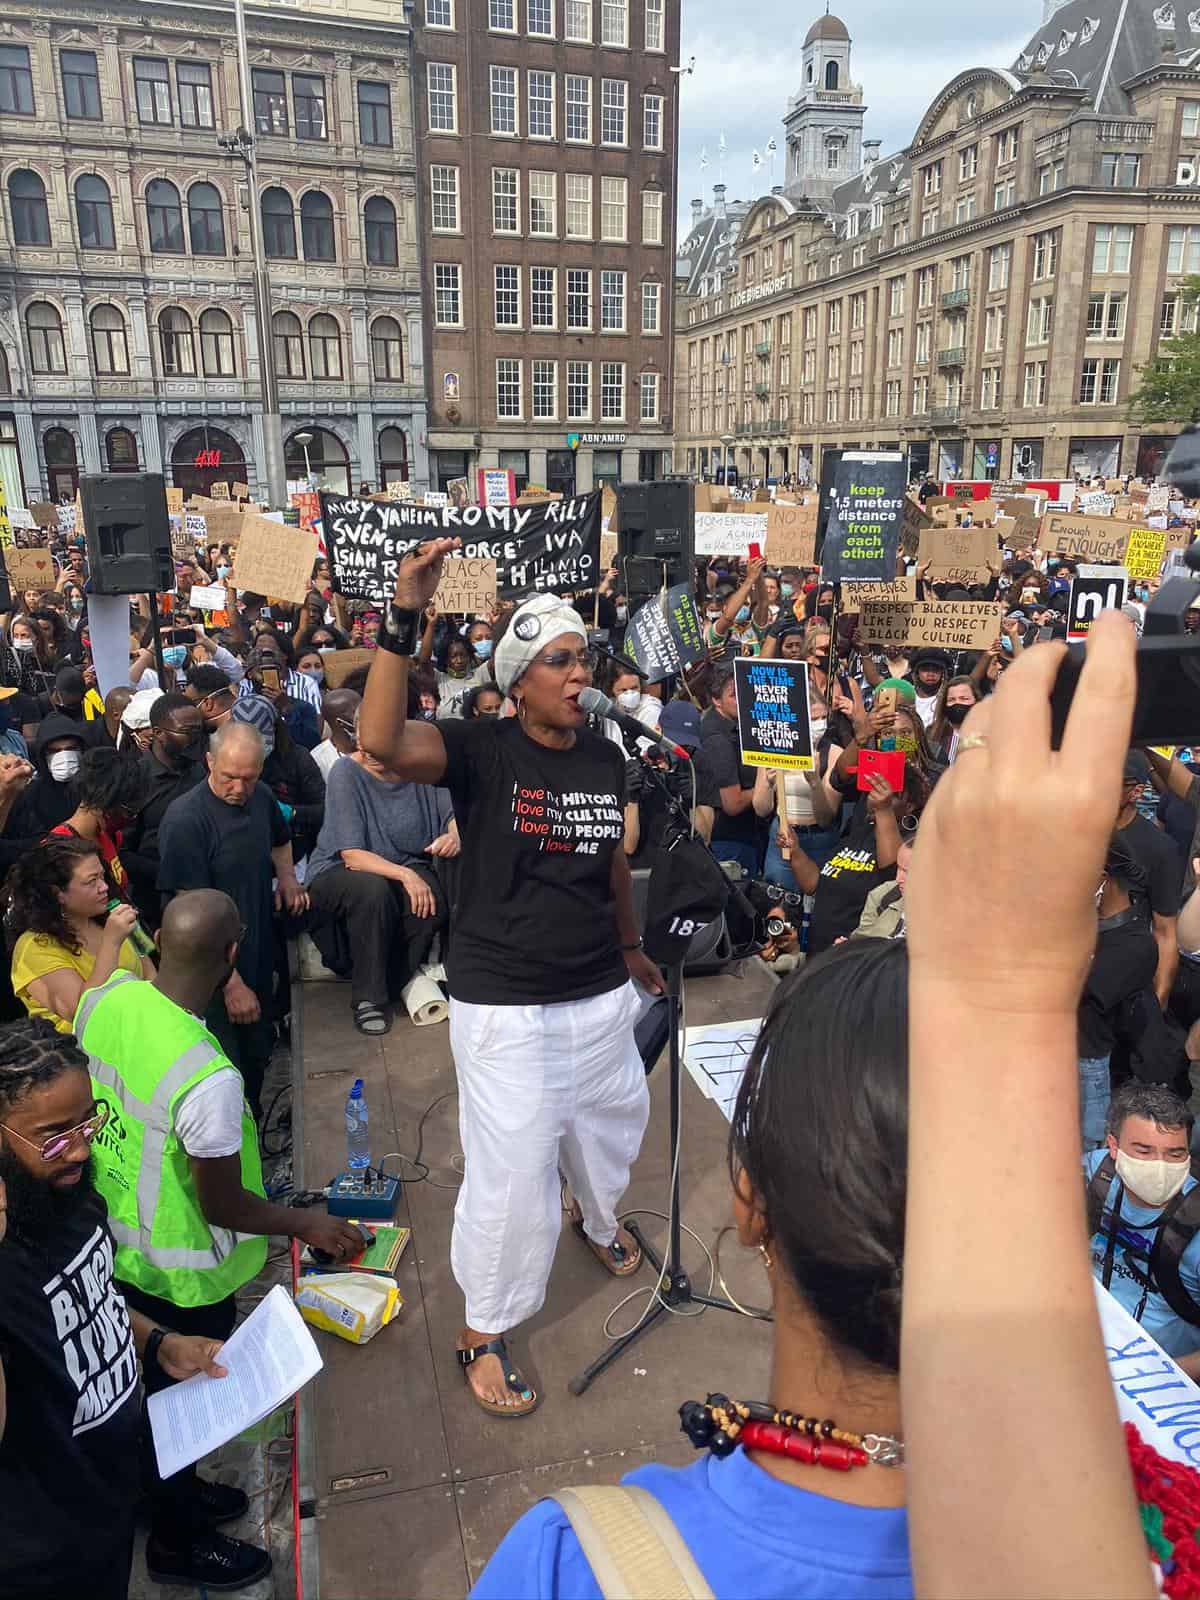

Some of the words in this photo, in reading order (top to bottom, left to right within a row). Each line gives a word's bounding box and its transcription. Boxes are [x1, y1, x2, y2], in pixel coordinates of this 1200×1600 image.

[850, 483, 885, 497] keep
[327, 499, 374, 522] MICKY
[835, 497, 850, 510] 1,5
[854, 497, 903, 509] meters
[442, 505, 532, 533] ROMY
[774, 510, 797, 528] NO
[838, 509, 897, 521] distance
[332, 518, 388, 547] SVEN
[848, 522, 881, 534] from
[545, 529, 583, 551] IVA
[846, 535, 881, 546] each
[842, 548, 884, 559] other!
[440, 560, 490, 579] BLACK
[443, 579, 479, 590] LIVES
[535, 570, 589, 591] FAREL
[847, 582, 876, 594] BLACK
[880, 580, 908, 594] LIVES
[433, 591, 496, 610] MATTER
[1076, 583, 1117, 619] nl
[864, 602, 918, 614] RESPECT
[922, 603, 959, 614] BLACK
[962, 604, 999, 617] LIVES
[863, 616, 894, 627] LIKE
[904, 617, 926, 628] YOU
[934, 618, 988, 631] RESPECT
[636, 621, 660, 667] AGAINST
[867, 629, 909, 641] BLACK
[921, 631, 973, 645] CULTURE
[751, 666, 776, 676] NOW
[777, 667, 788, 677] IS
[746, 674, 769, 686] THE
[770, 676, 795, 687] TIME
[754, 684, 788, 695] NEVER
[756, 694, 788, 704] AGAIN
[754, 702, 779, 713] NOW
[780, 704, 791, 713] IS
[749, 709, 770, 720] THE
[772, 711, 798, 723] TIME
[758, 719, 790, 732] WE'RE
[751, 727, 799, 740] FIGHTING
[757, 736, 772, 747] TO
[773, 738, 793, 749] WIN
[520, 788, 545, 800] ove
[511, 798, 516, 813] i
[516, 799, 544, 816] love
[513, 816, 519, 832] i
[520, 817, 549, 835] love
[552, 824, 572, 839] my
[538, 838, 545, 851] i
[545, 838, 573, 853] love
[574, 841, 600, 855] ME
